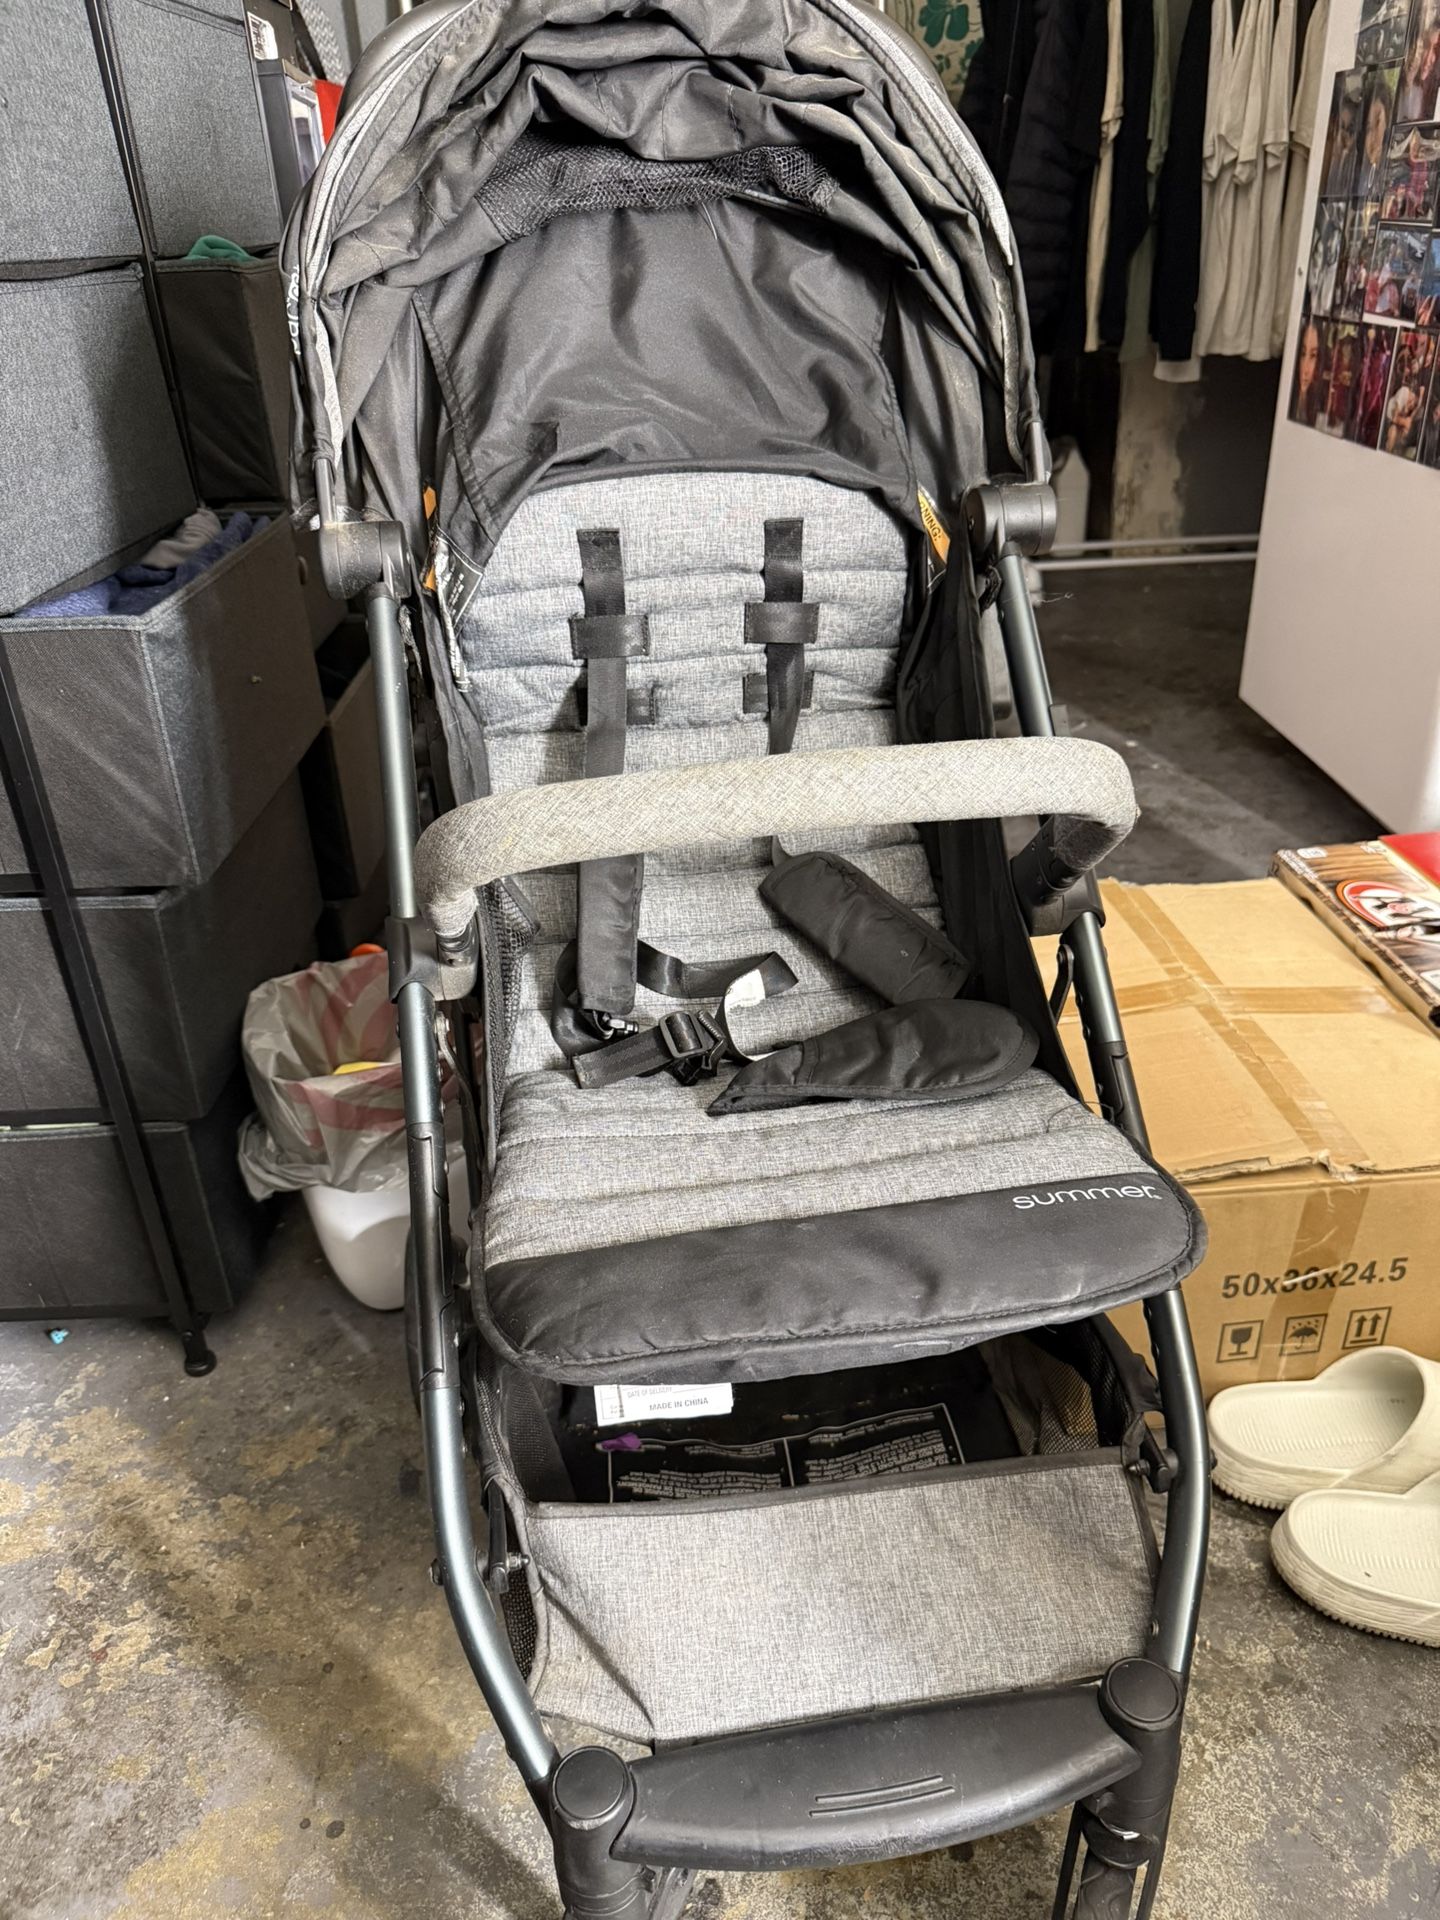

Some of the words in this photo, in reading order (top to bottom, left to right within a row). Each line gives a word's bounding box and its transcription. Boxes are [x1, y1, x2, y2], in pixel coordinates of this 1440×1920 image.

[1012, 1185, 1157, 1209] summer
[649, 1402, 673, 1411] MADE
[674, 1400, 682, 1408] IN
[684, 1397, 709, 1407] CHINA
